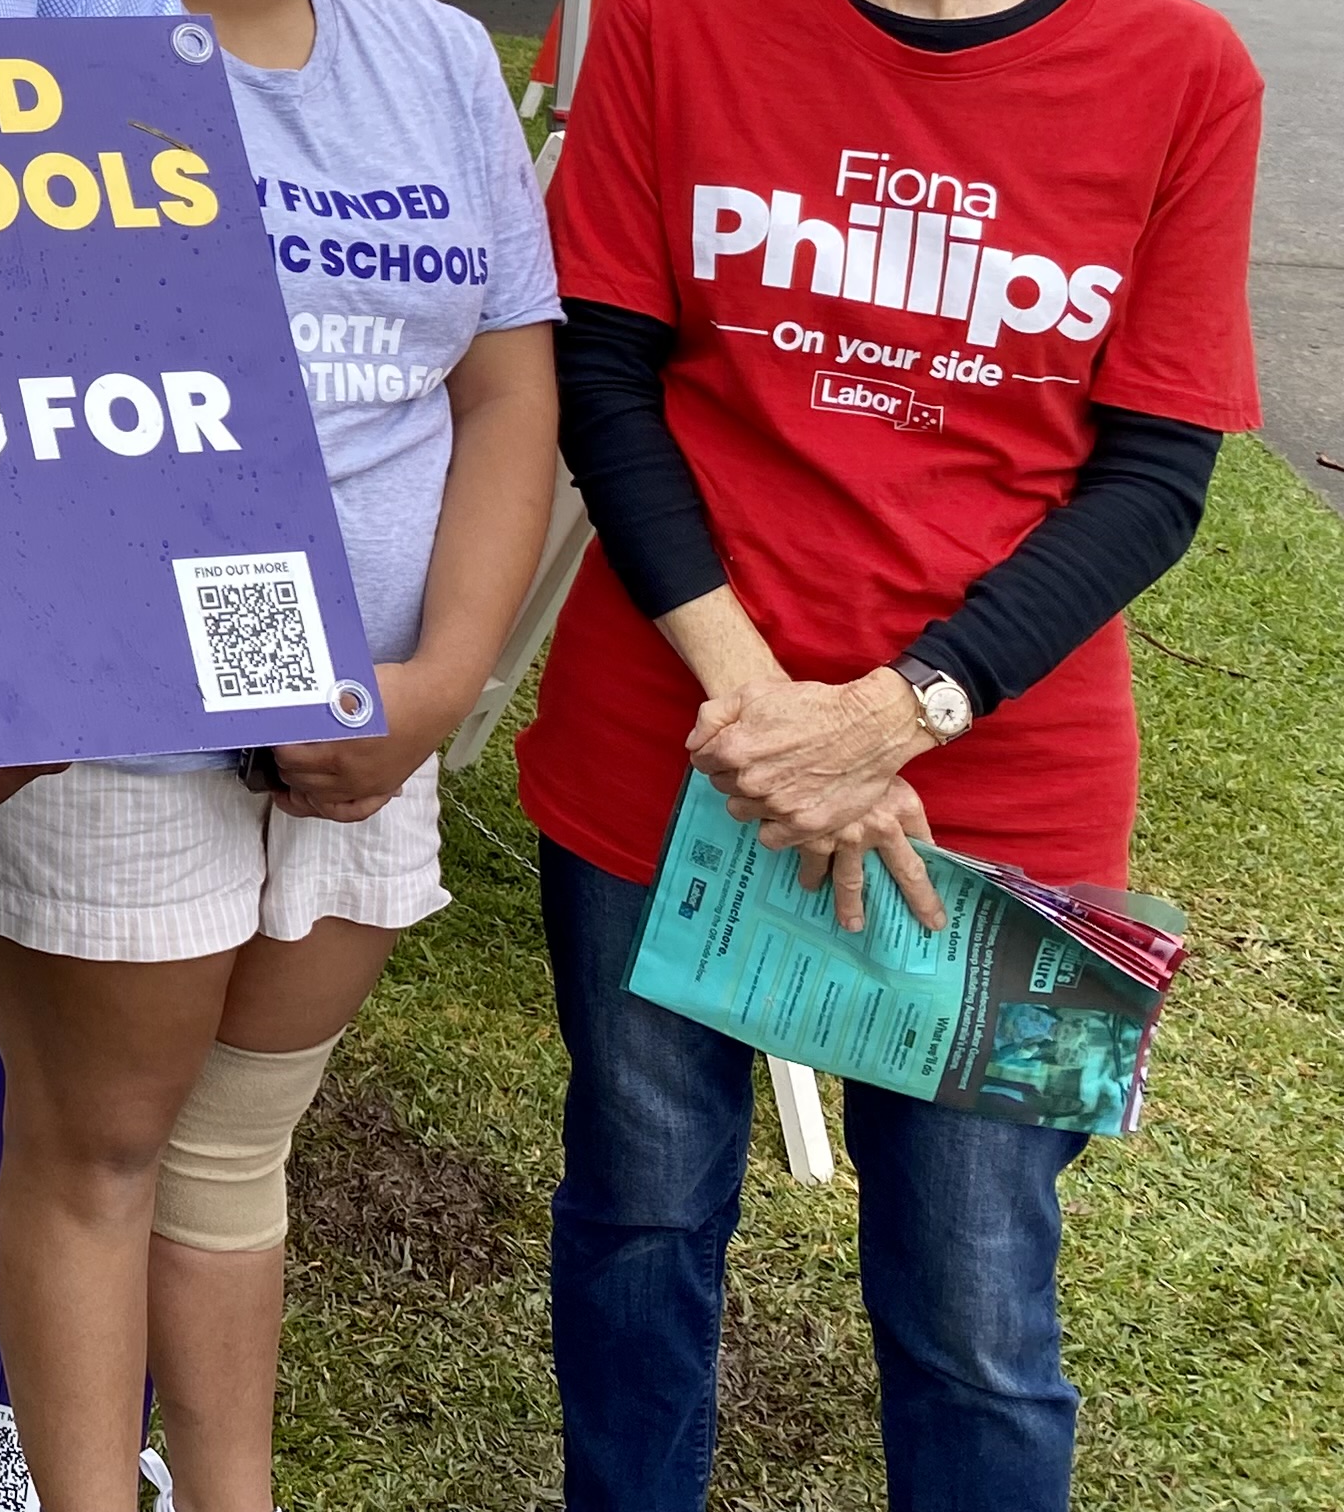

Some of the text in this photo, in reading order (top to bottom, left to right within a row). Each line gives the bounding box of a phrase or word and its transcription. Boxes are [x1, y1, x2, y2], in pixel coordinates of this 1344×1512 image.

[278, 180, 450, 220] FUNDED
[836, 149, 997, 218] Fiona
[320, 239, 488, 285] SCHOOLS
[693, 184, 1123, 348] Phillips
[291, 312, 406, 355] ORTH
[773, 320, 1003, 386] On your side
[301, 362, 407, 403] TING
[821, 379, 901, 415] Labor
[20, 369, 241, 461] FOR
[194, 562, 288, 578] FIND OUT MORE
[716, 875, 748, 957] so much more.
[948, 935, 959, 962] done
[1034, 940, 1060, 988] Future
